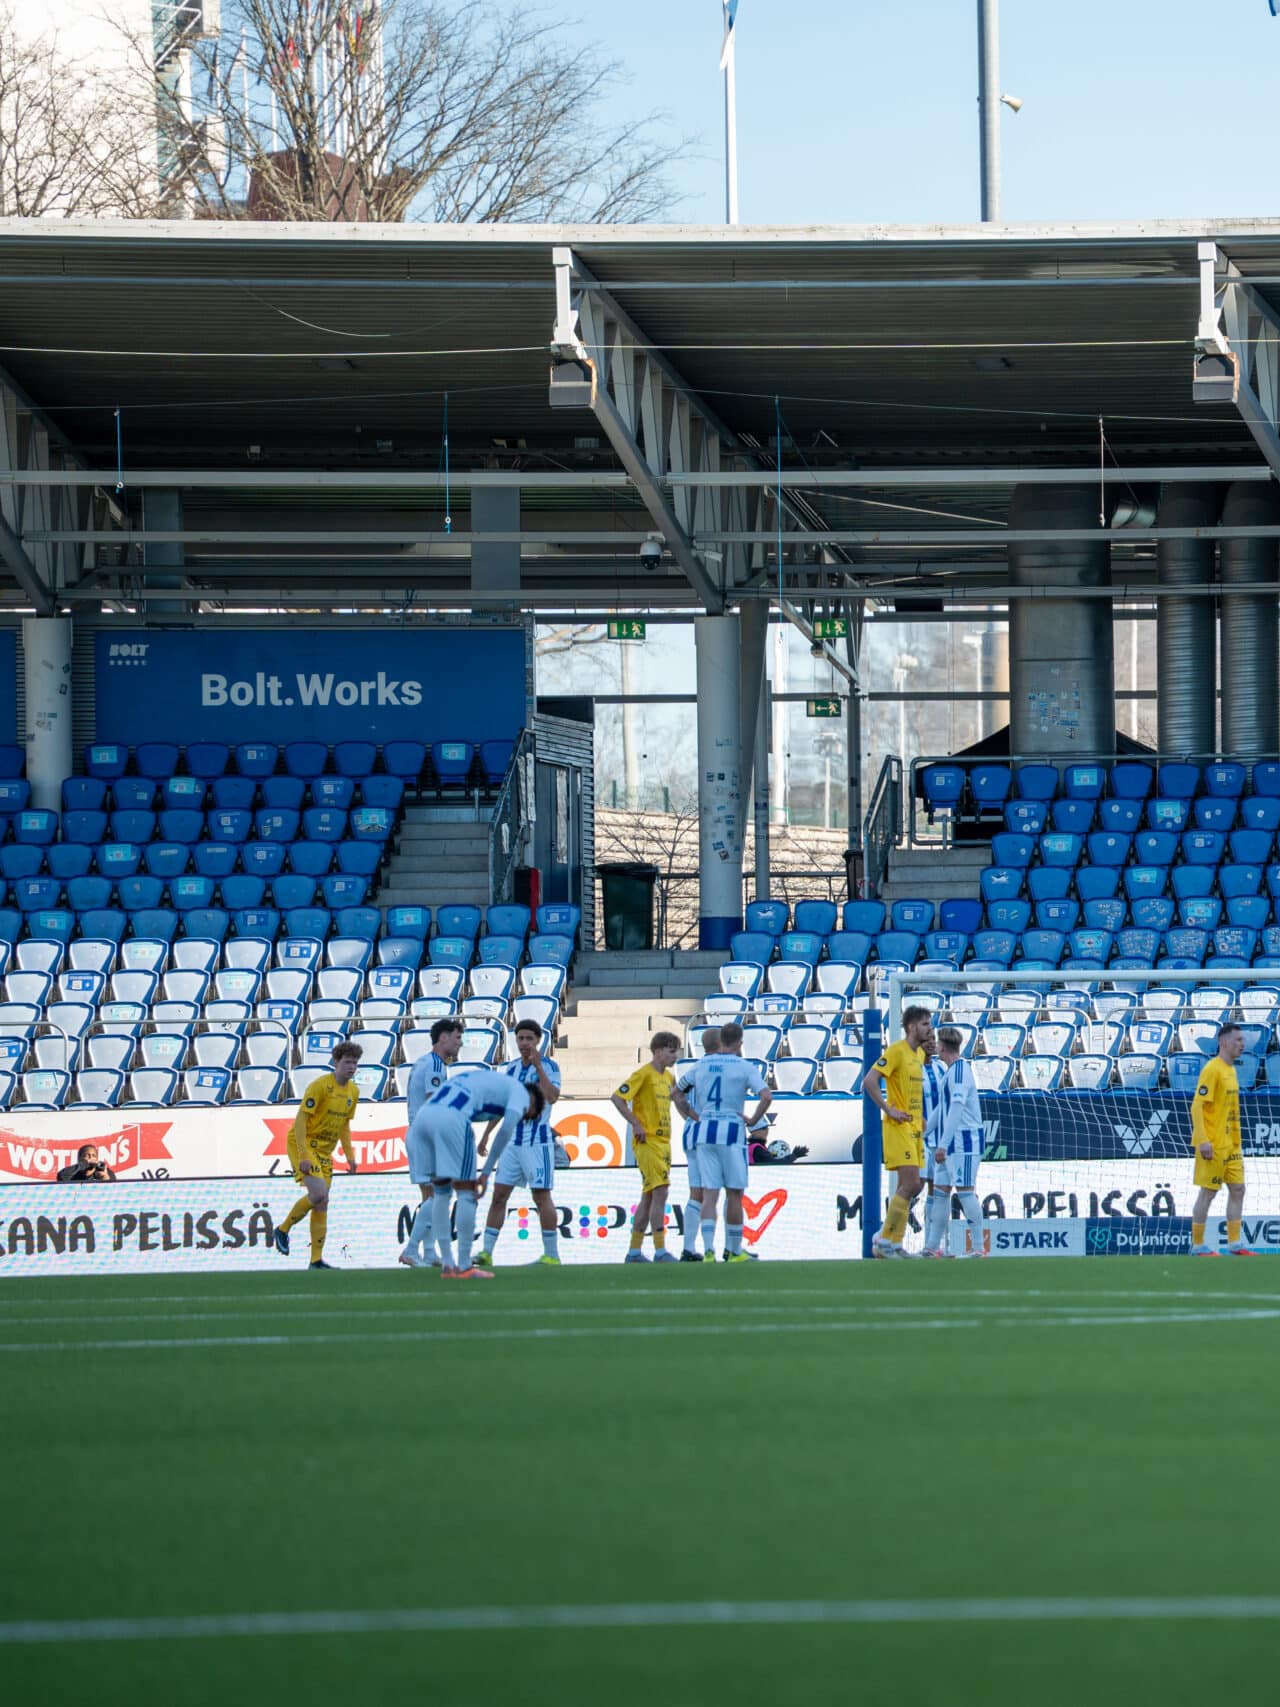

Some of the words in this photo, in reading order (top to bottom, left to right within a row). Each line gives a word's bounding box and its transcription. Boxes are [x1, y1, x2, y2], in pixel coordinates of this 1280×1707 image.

[109, 644, 150, 657] BOLT
[201, 672, 422, 706] Bolt.Works
[707, 1076, 723, 1111] 4
[905, 1151, 911, 1160] 5
[1022, 1182, 1177, 1218] PELISSÄ
[112, 1203, 275, 1252] PELISSÄ
[996, 1231, 1070, 1250] STARK
[1116, 1231, 1193, 1247] Duunitori
